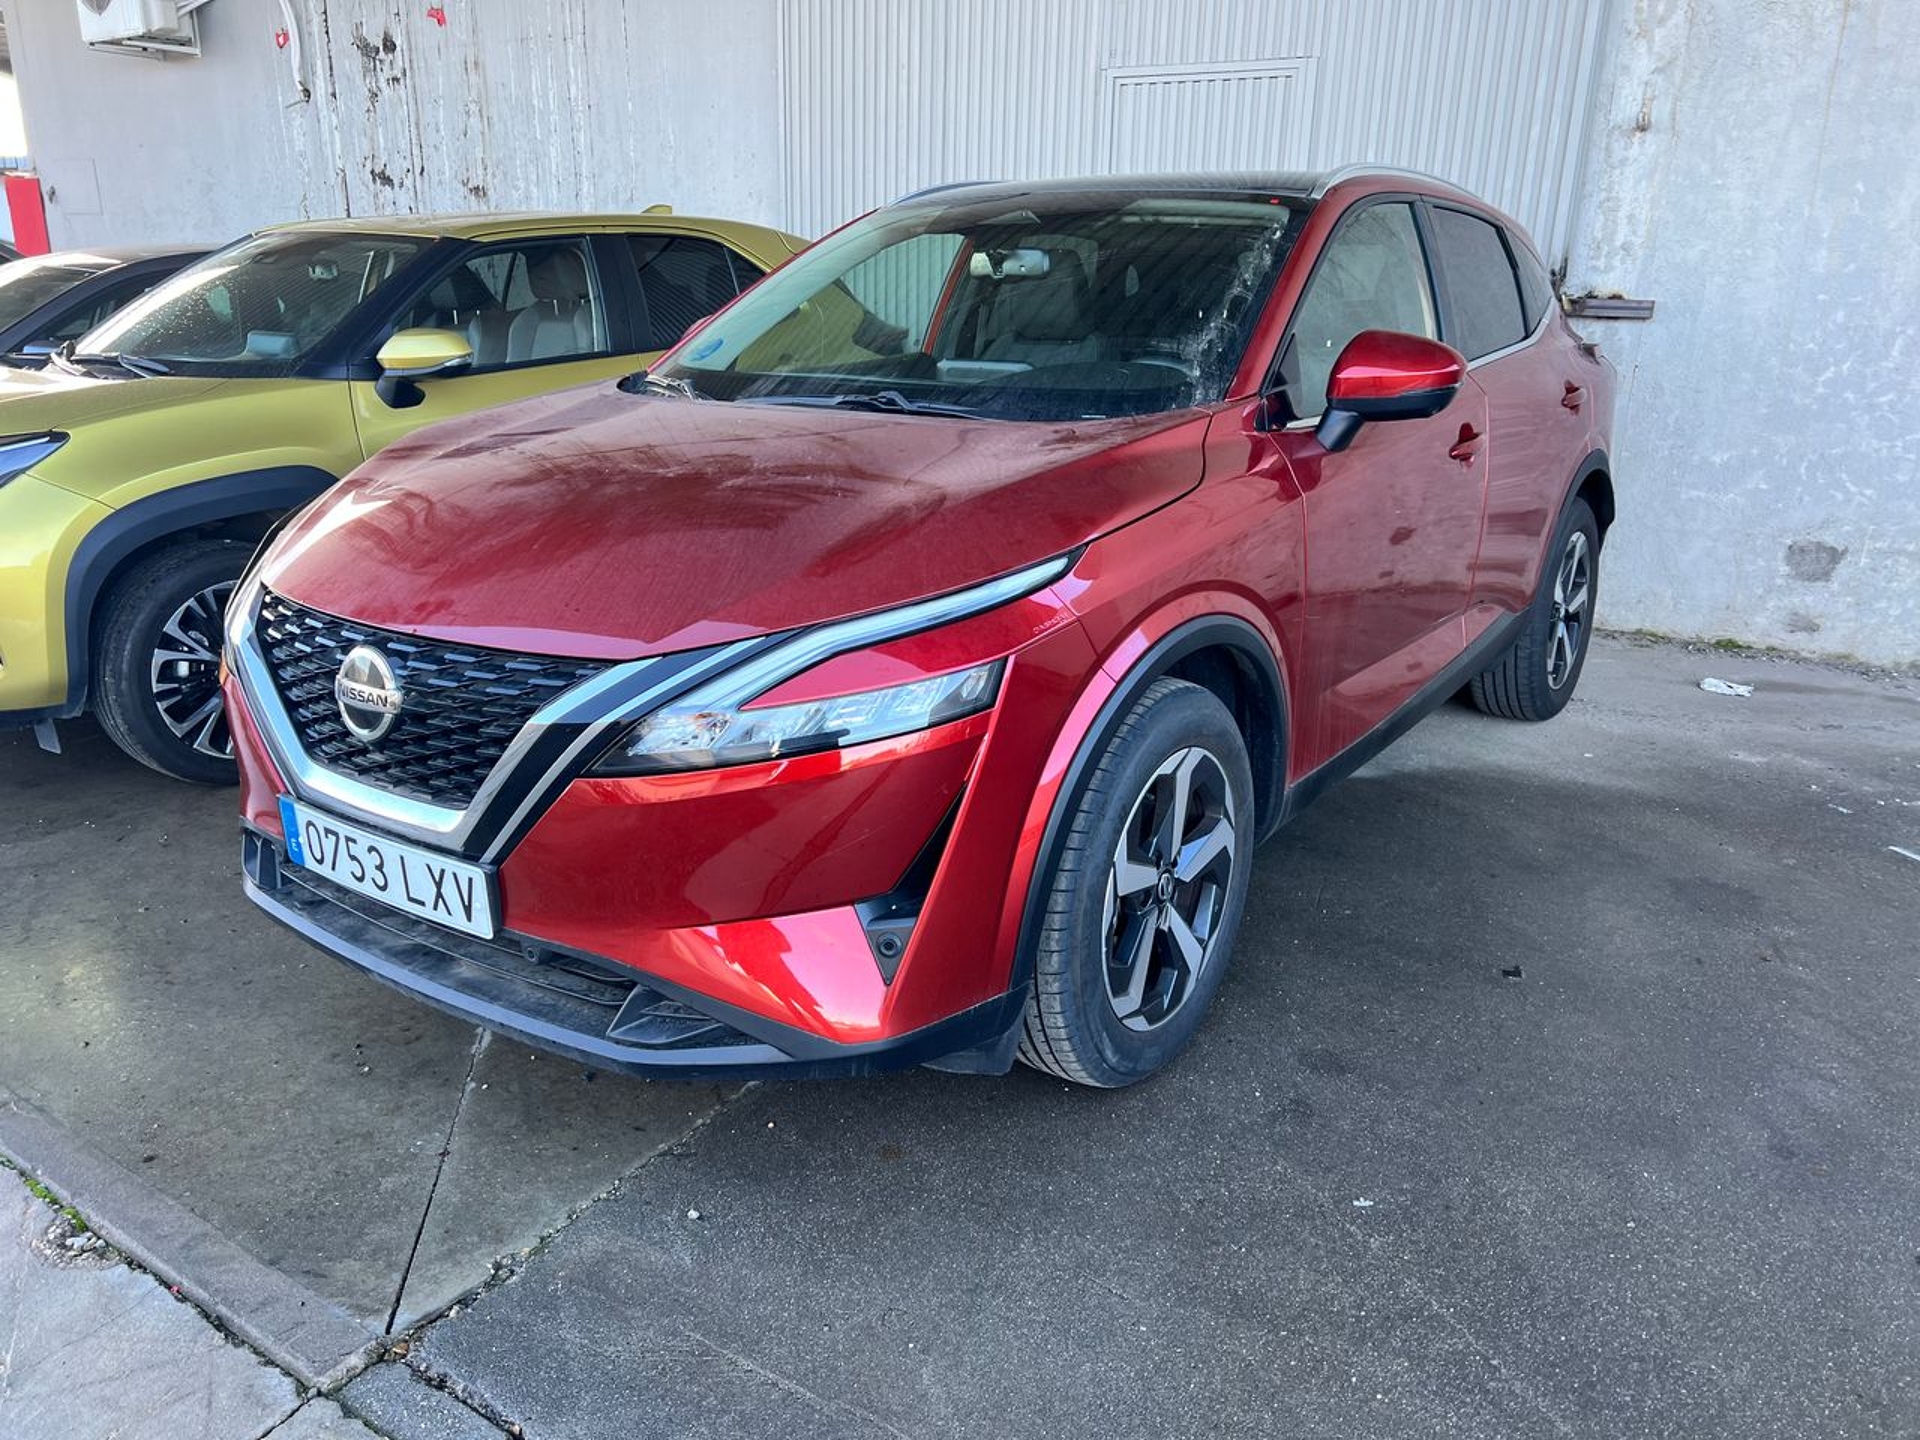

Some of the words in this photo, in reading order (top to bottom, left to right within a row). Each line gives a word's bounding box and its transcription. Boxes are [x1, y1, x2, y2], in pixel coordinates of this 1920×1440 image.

[341, 684, 388, 707] NISSAN
[305, 820, 389, 893] 0753
[400, 855, 473, 923] LXV
